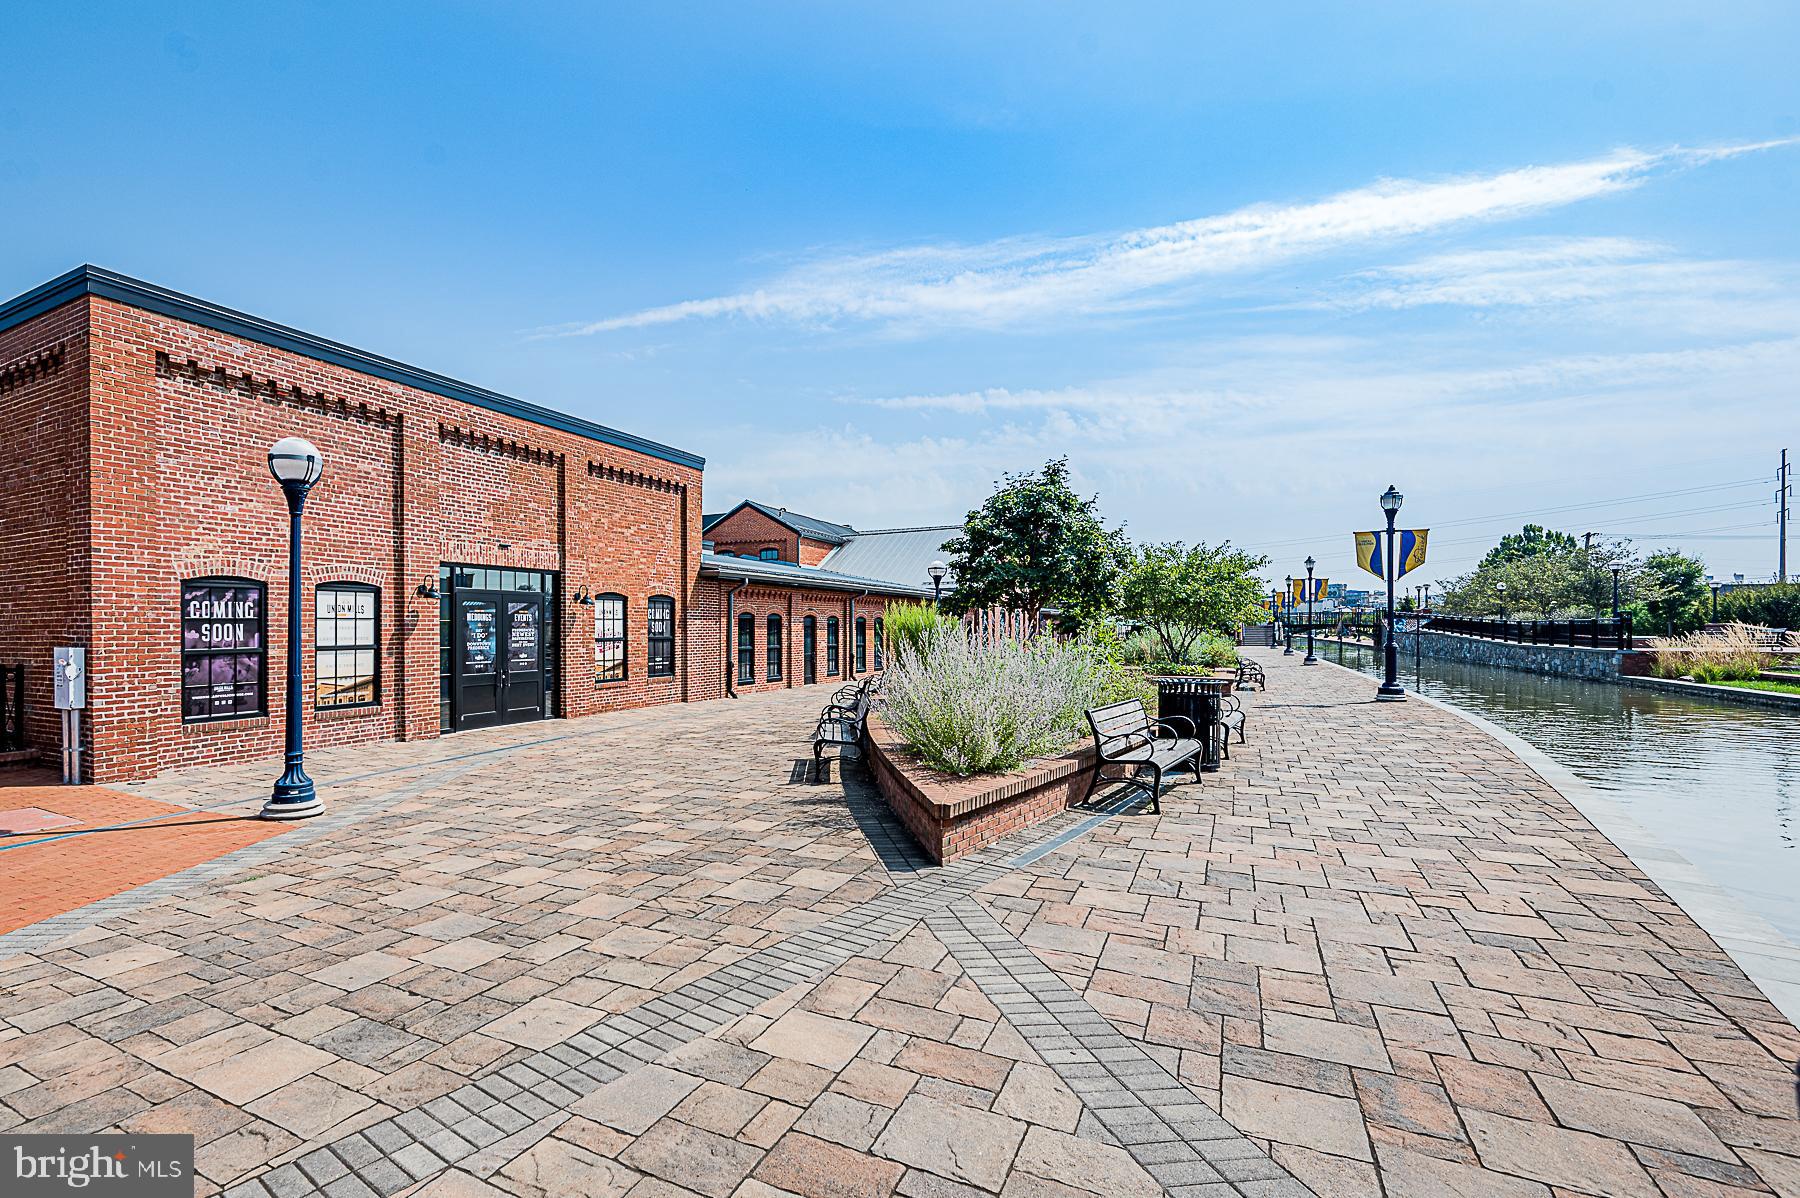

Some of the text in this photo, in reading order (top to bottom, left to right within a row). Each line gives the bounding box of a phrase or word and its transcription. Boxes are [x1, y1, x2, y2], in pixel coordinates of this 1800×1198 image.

[189, 600, 254, 618] COMING
[326, 605, 346, 614] UNON
[466, 612, 492, 622] WEDDINGS
[514, 613, 532, 622] EVENTS
[201, 623, 244, 642] SOON
